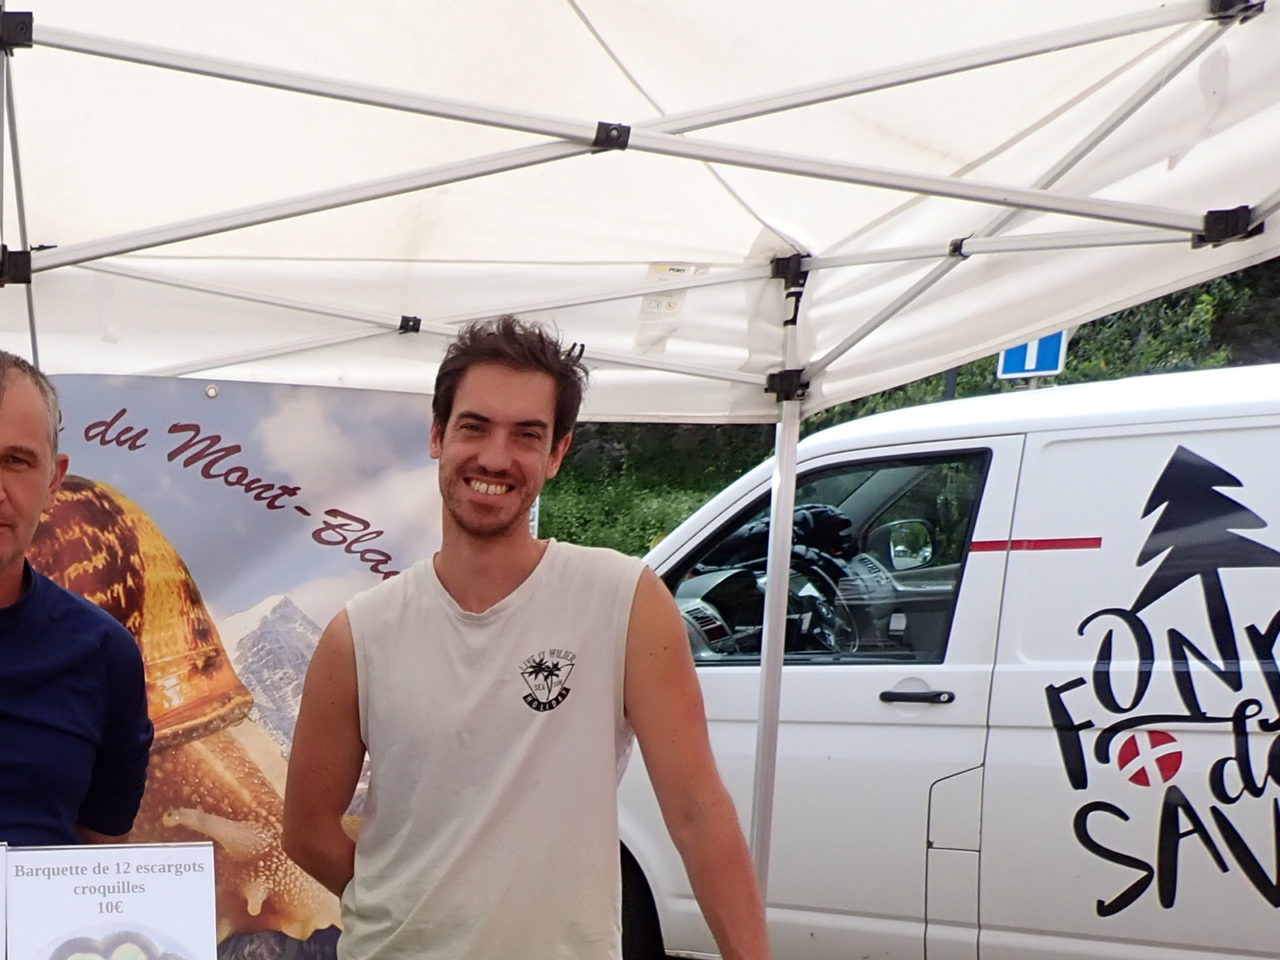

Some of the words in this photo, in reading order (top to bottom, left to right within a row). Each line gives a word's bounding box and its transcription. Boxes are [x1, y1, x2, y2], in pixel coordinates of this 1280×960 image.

[83, 408, 149, 451] du
[14, 864, 88, 879] Barquette
[93, 862, 109, 875] de
[115, 862, 131, 874] 12
[136, 861, 204, 877] escargots
[73, 881, 145, 897] croquilles
[97, 901, 124, 914] 10€
